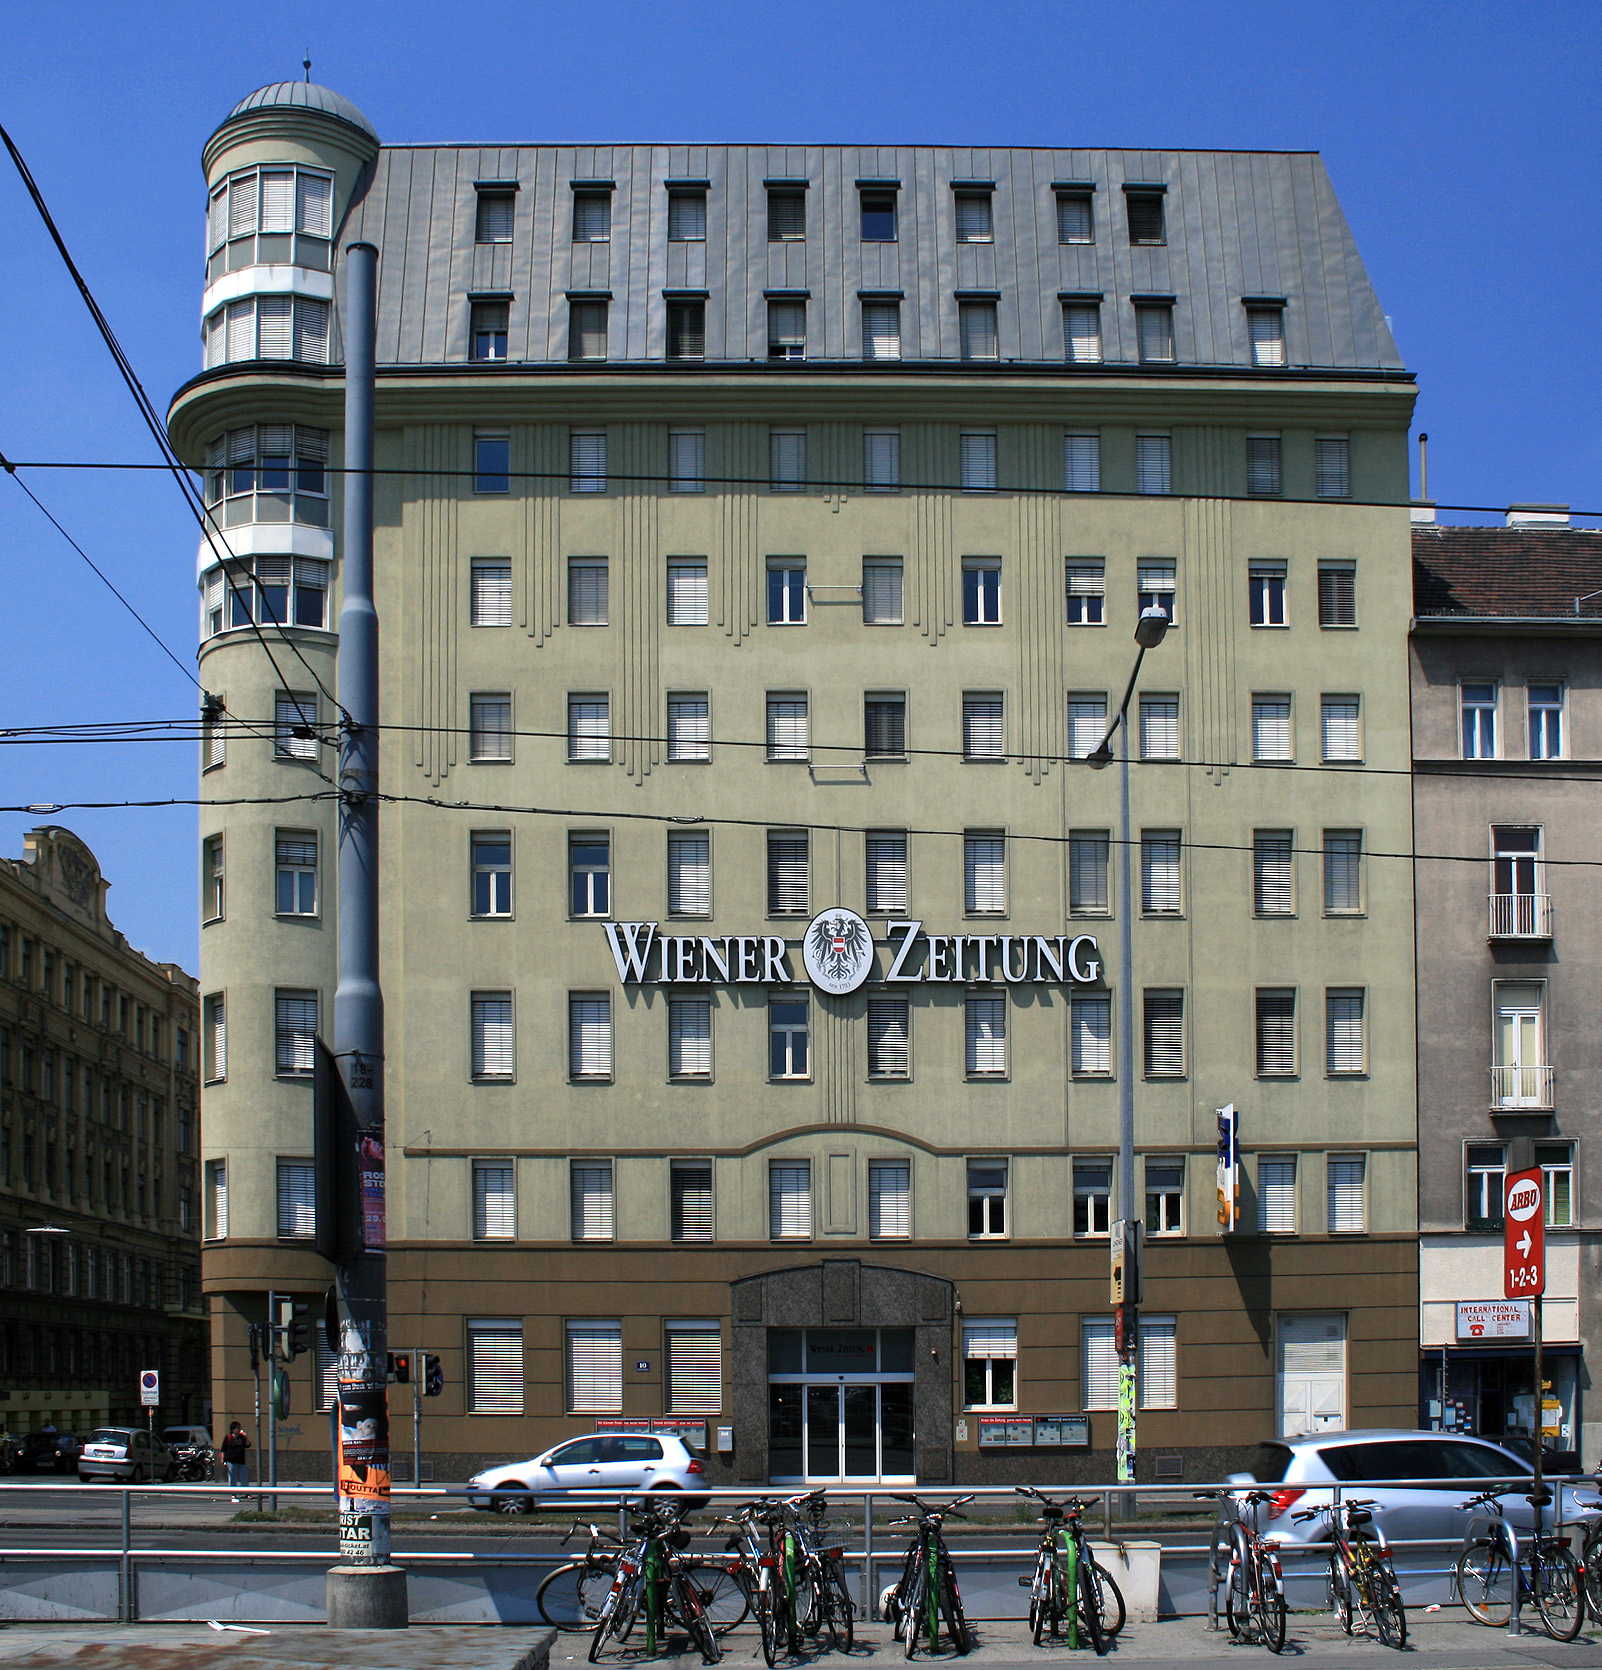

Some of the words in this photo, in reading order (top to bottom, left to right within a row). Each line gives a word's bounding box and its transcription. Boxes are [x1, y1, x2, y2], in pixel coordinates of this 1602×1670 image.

[601, 921, 791, 983] WIENER
[885, 919, 1099, 983] ZEITUNG
[1460, 1305, 1519, 1314] INTERNATIONAL
[1491, 1313, 1521, 1322] CENTER
[350, 1484, 378, 1494] OUTTA
[340, 1527, 371, 1540] TAR
